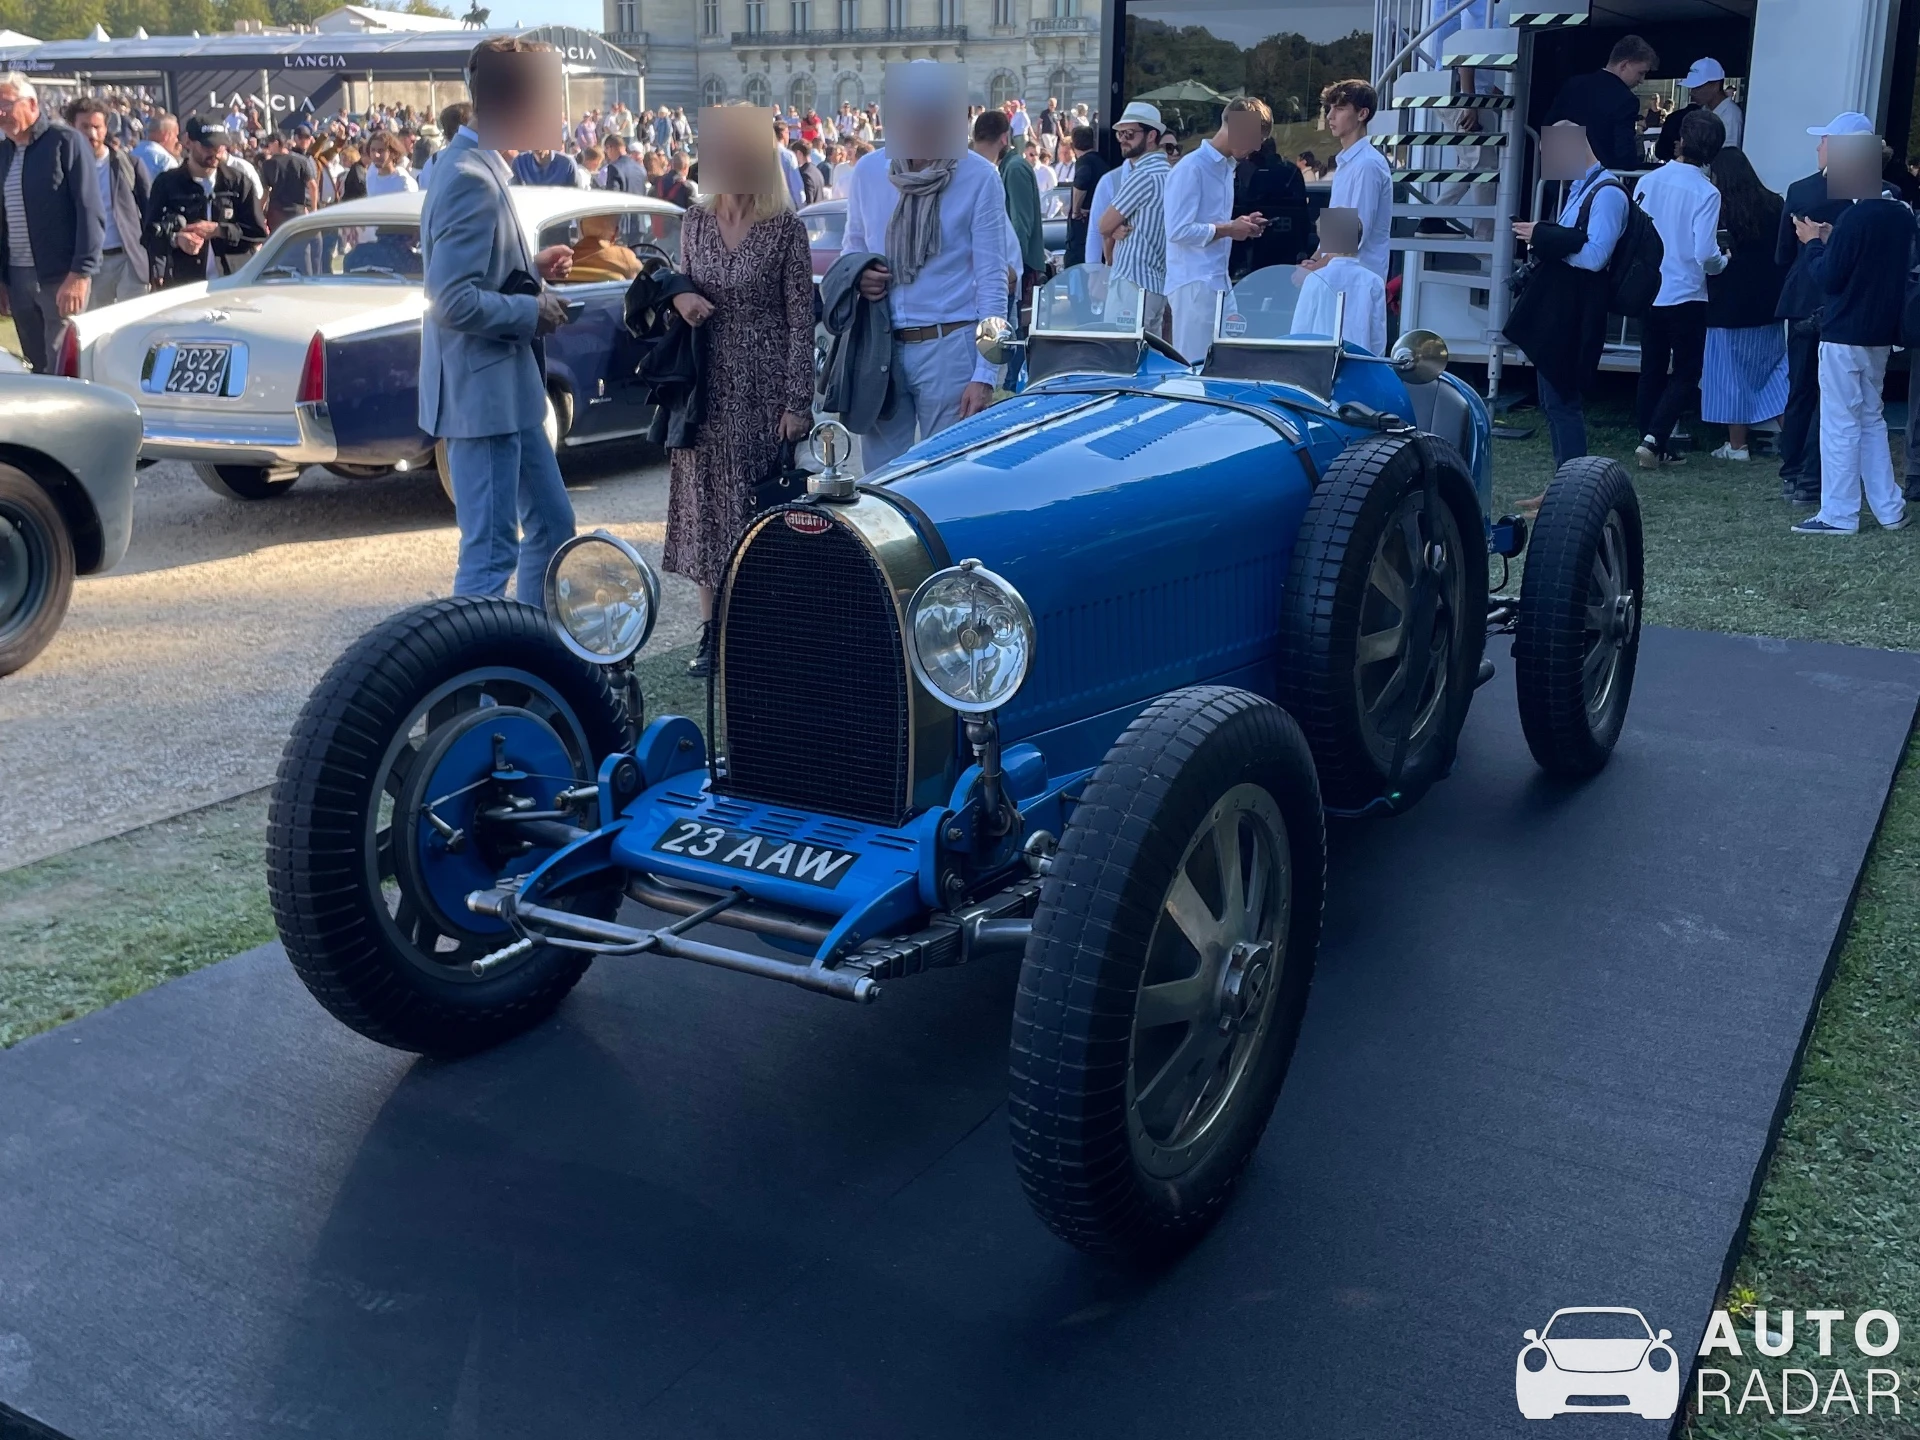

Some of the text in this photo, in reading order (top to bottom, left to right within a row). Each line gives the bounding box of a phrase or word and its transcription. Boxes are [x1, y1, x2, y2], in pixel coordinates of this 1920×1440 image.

[284, 55, 347, 68] LANCIA
[210, 90, 316, 113] LANCIA
[174, 348, 226, 371] PC27
[167, 370, 221, 393] 4296
[661, 822, 853, 882] 23 AAW
